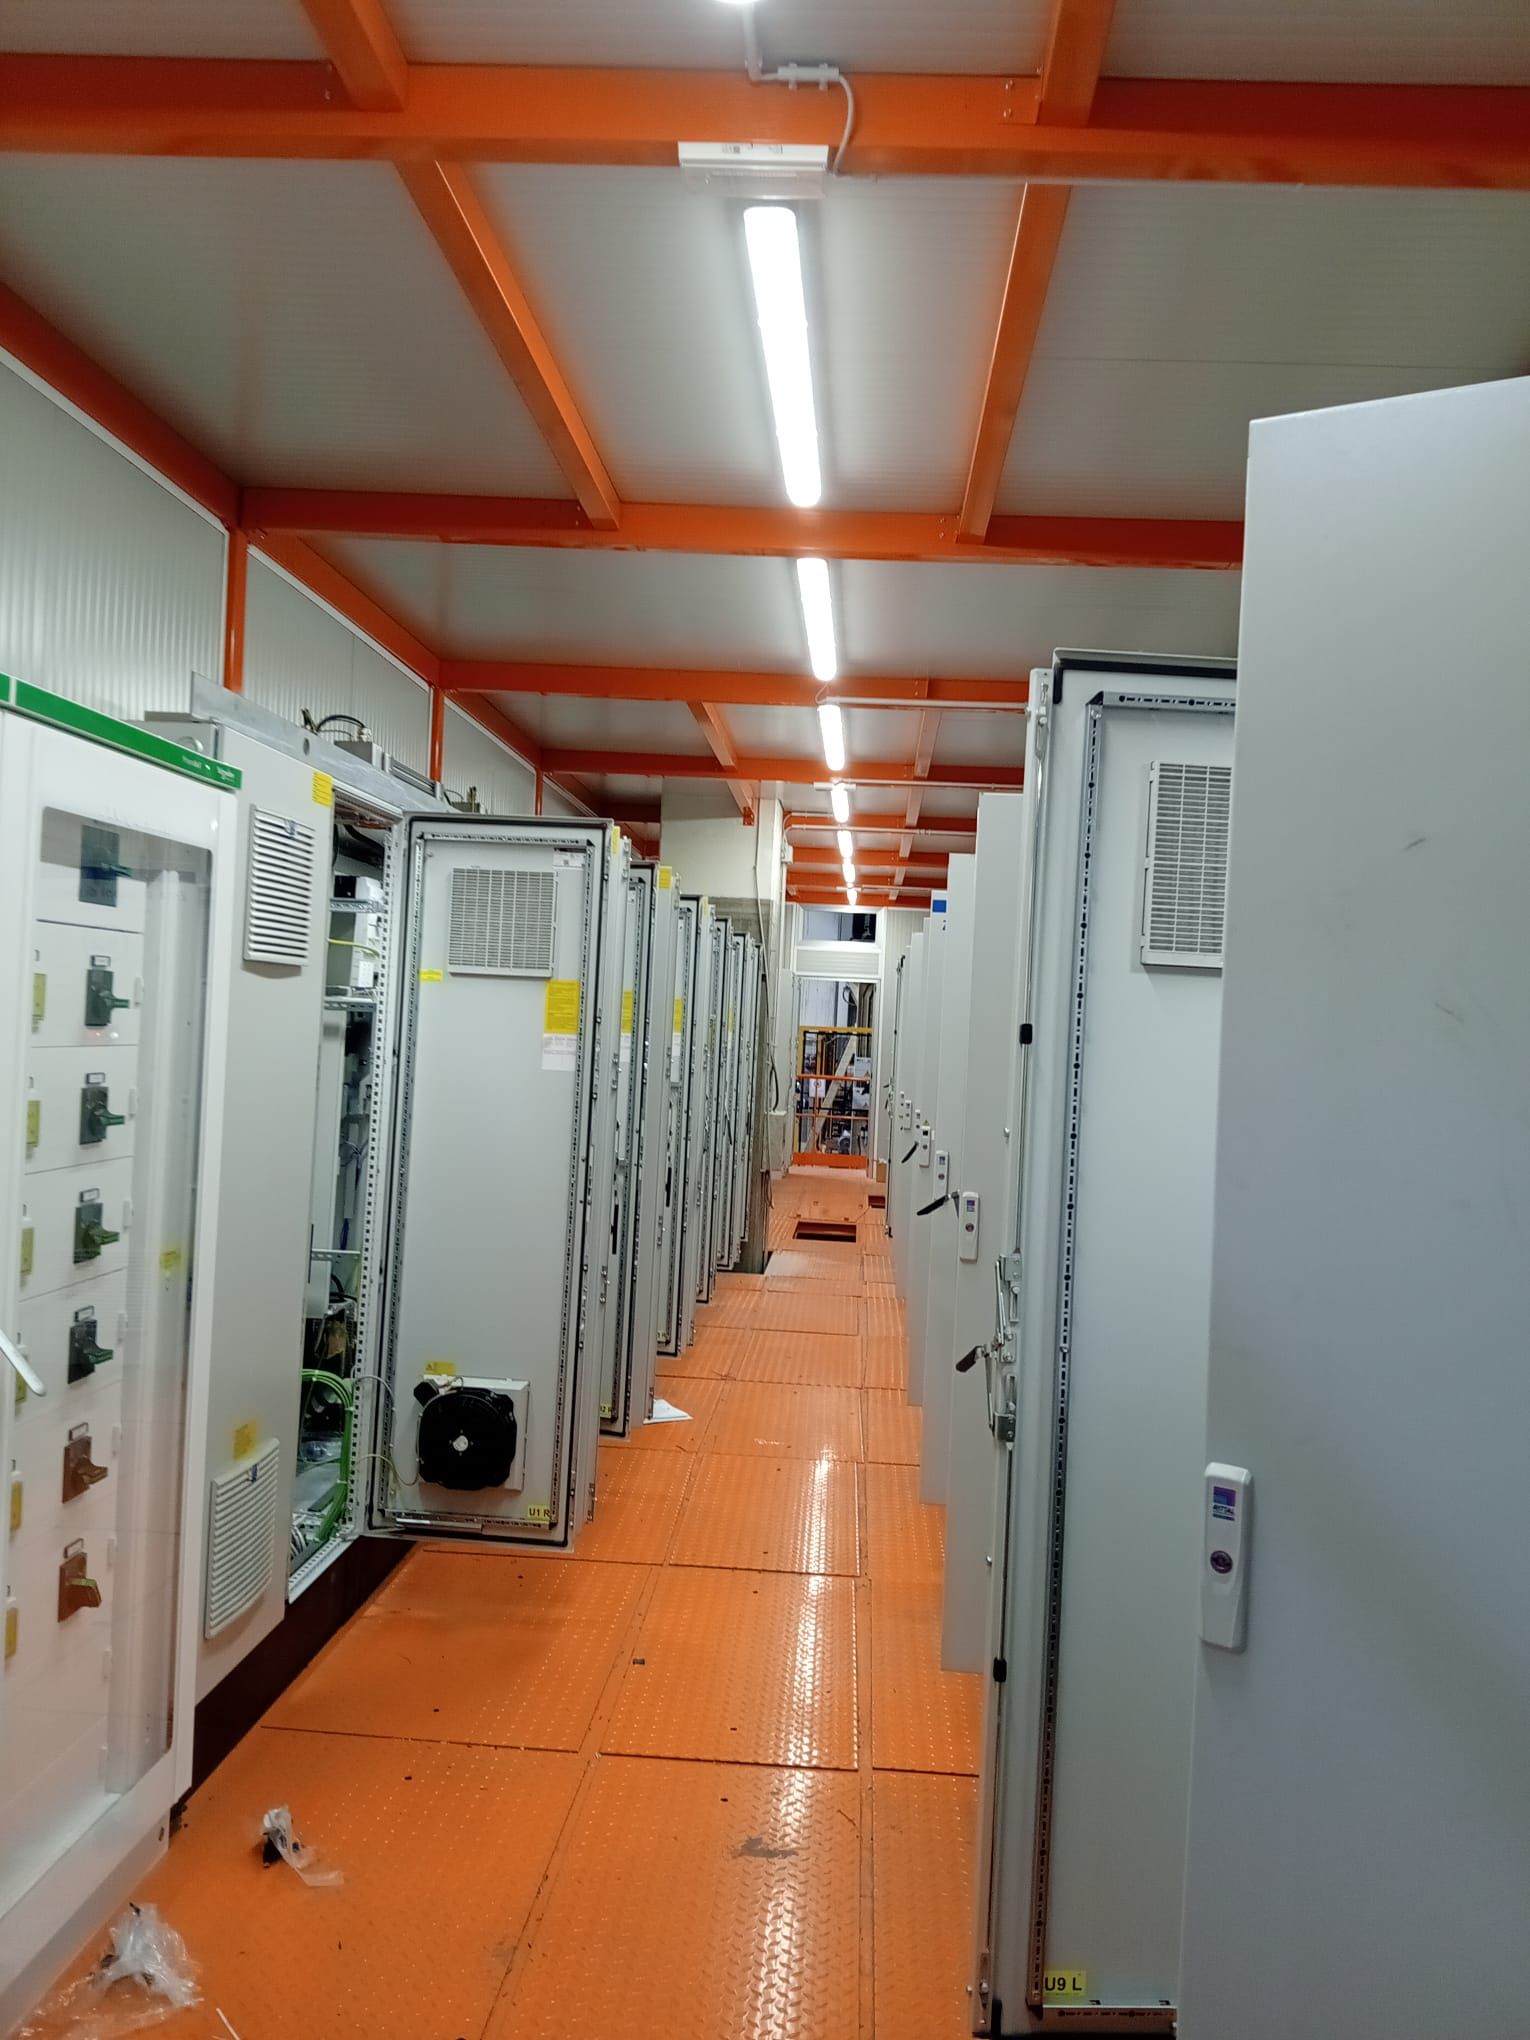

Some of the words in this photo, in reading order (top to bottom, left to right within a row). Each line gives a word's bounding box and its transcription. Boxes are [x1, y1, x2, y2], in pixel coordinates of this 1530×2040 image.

[529, 1508, 540, 1517] U1
[543, 1508, 551, 1518] R
[1045, 1977, 1066, 1991] U9
[1072, 1977, 1082, 1991] L
